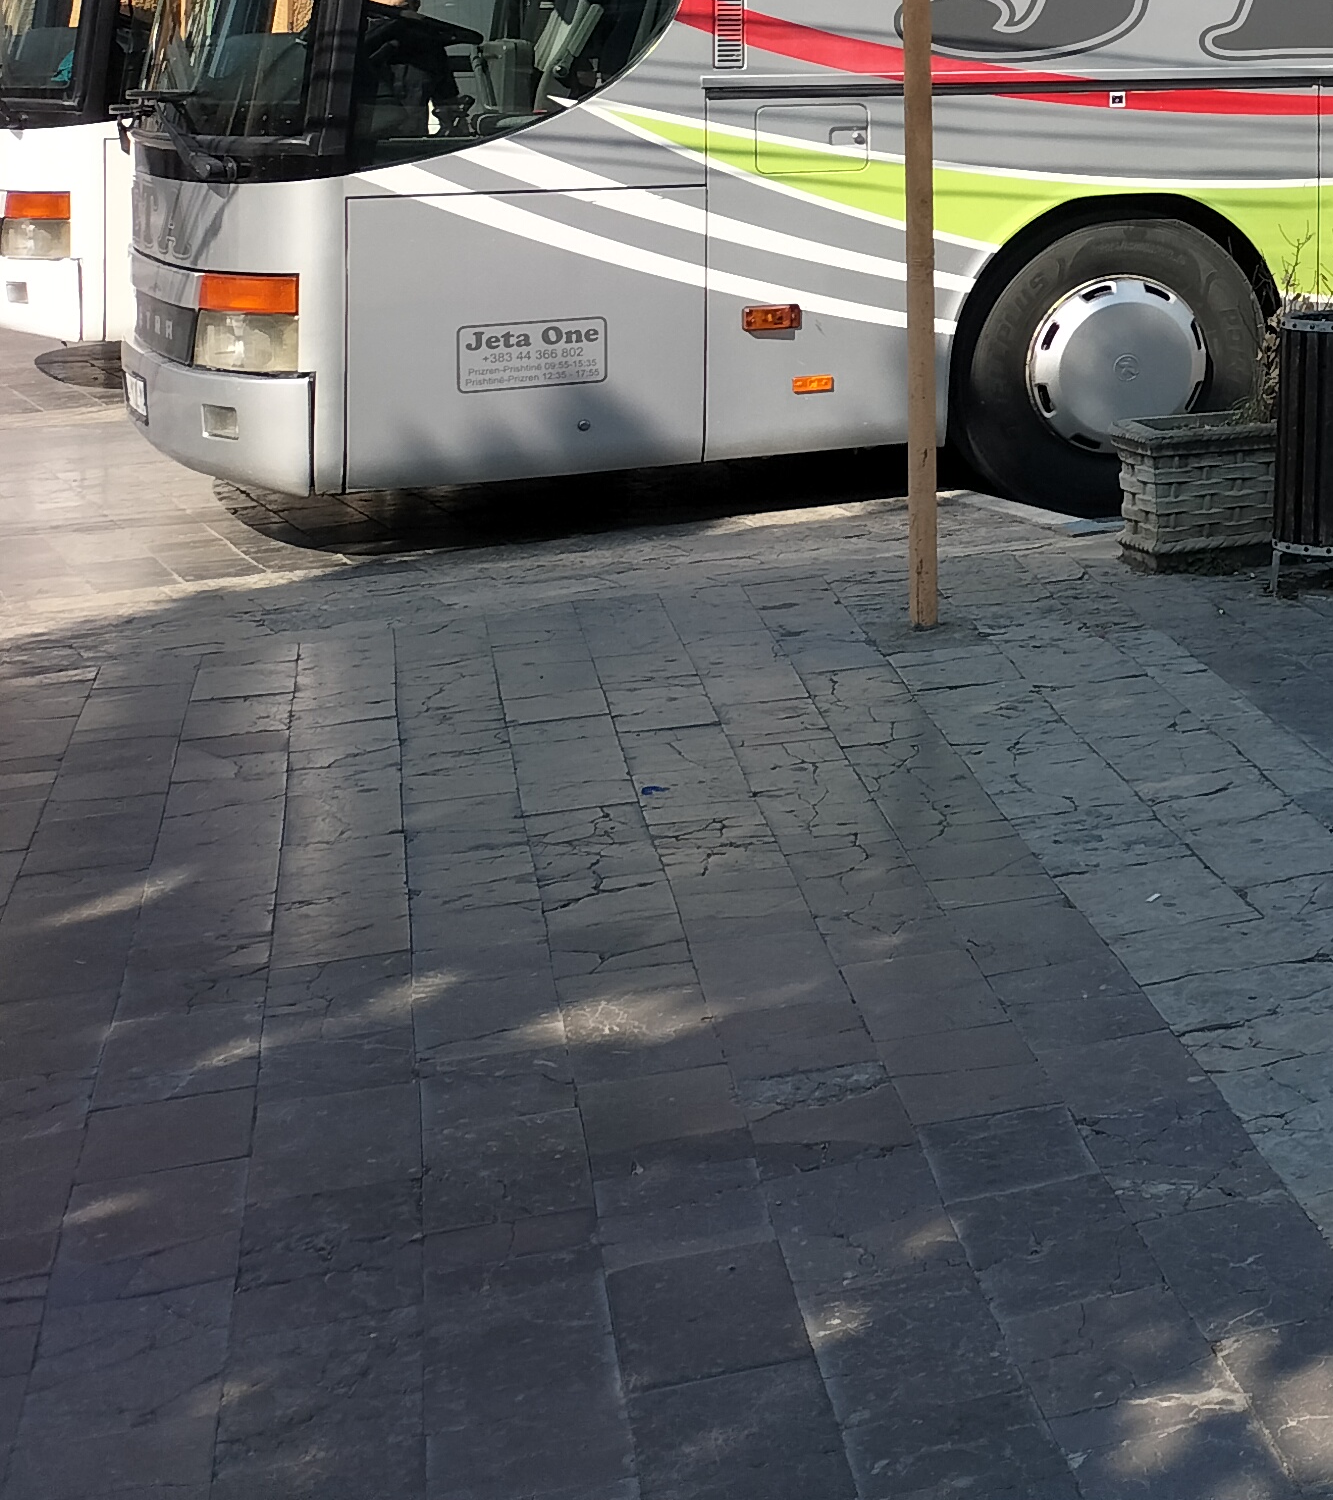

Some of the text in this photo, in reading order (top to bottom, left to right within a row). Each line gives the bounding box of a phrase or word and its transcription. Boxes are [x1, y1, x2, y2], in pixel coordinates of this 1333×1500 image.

[466, 326, 599, 351] Jeta One
[482, 346, 584, 364] +383 44 366 802
